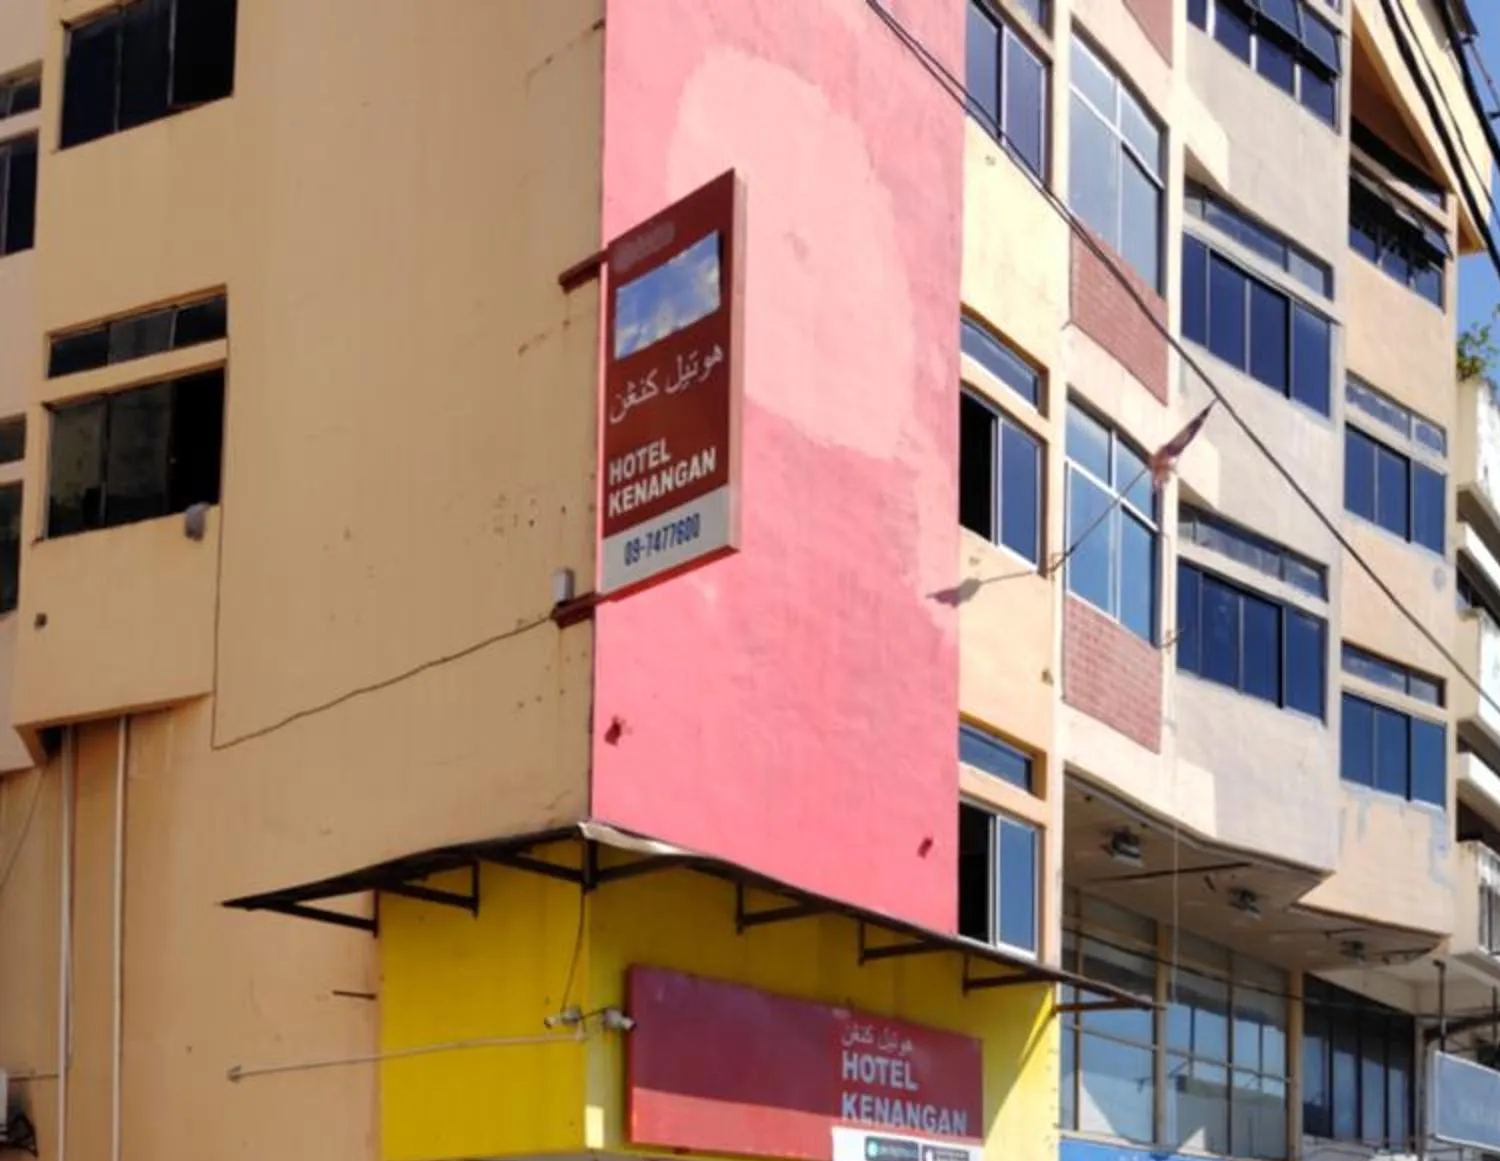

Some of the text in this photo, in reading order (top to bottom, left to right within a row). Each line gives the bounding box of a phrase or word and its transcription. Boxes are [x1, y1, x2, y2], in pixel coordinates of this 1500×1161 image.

[608, 447, 717, 519] KENANGAN
[609, 437, 671, 485] HOTEL
[623, 512, 701, 567] 09-7477600
[841, 1048, 920, 1092] HOTEL
[841, 1090, 968, 1137] KENANGAN
